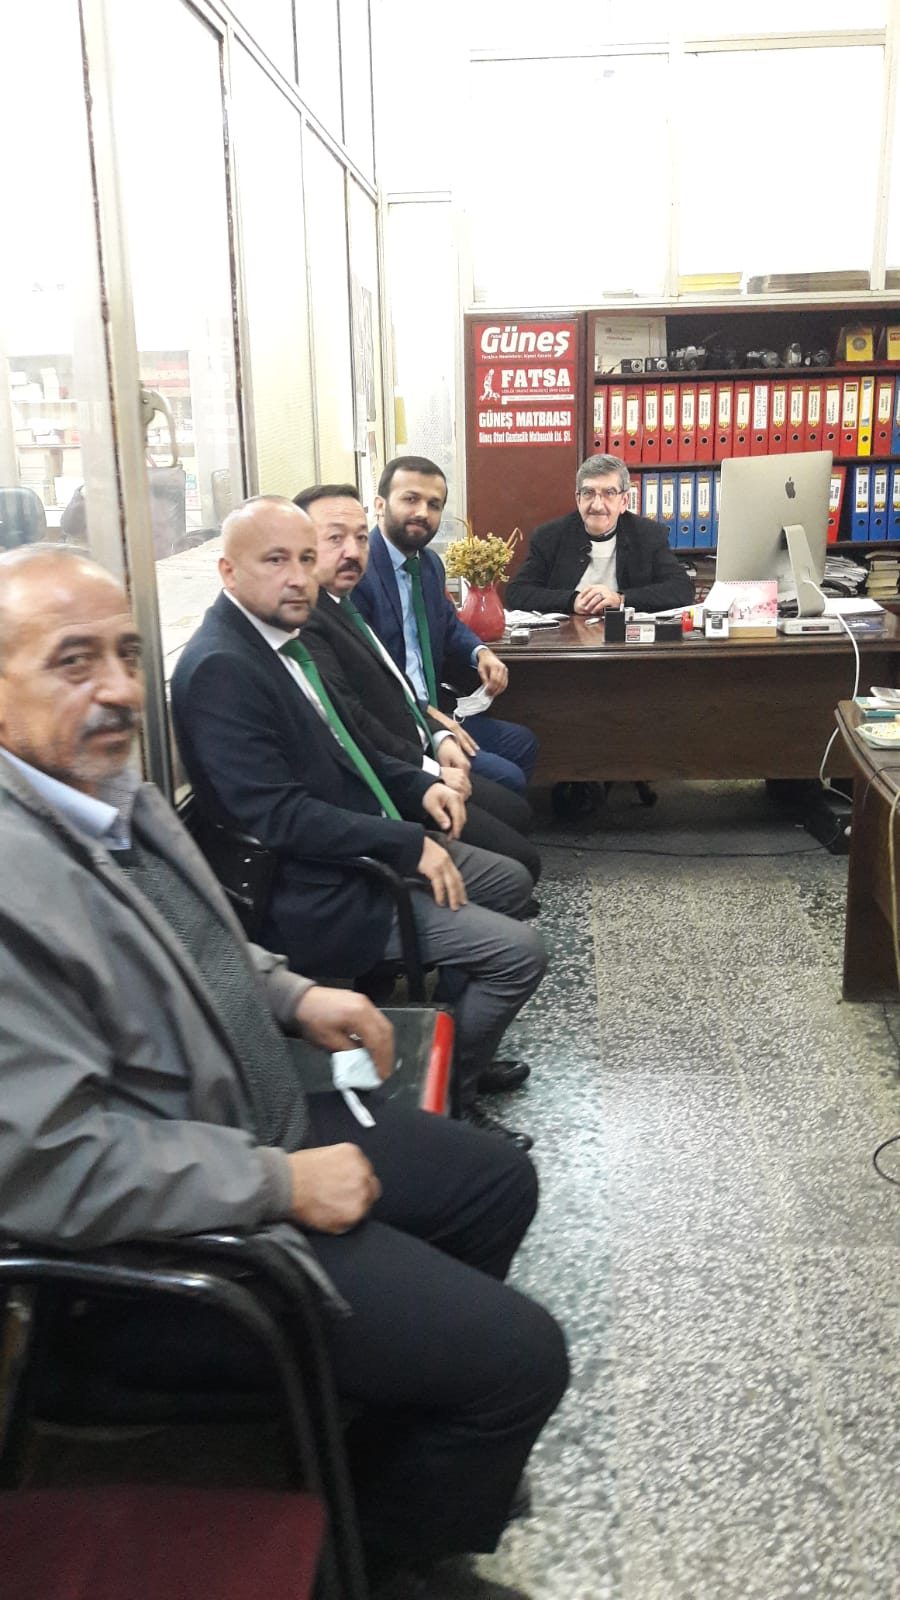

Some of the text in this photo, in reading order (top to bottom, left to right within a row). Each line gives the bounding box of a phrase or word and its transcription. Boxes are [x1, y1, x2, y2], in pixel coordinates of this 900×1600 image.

[481, 326, 570, 357] Güneş
[501, 368, 571, 388] FATSA
[478, 410, 571, 429] GÜNEŞ MATBAASI
